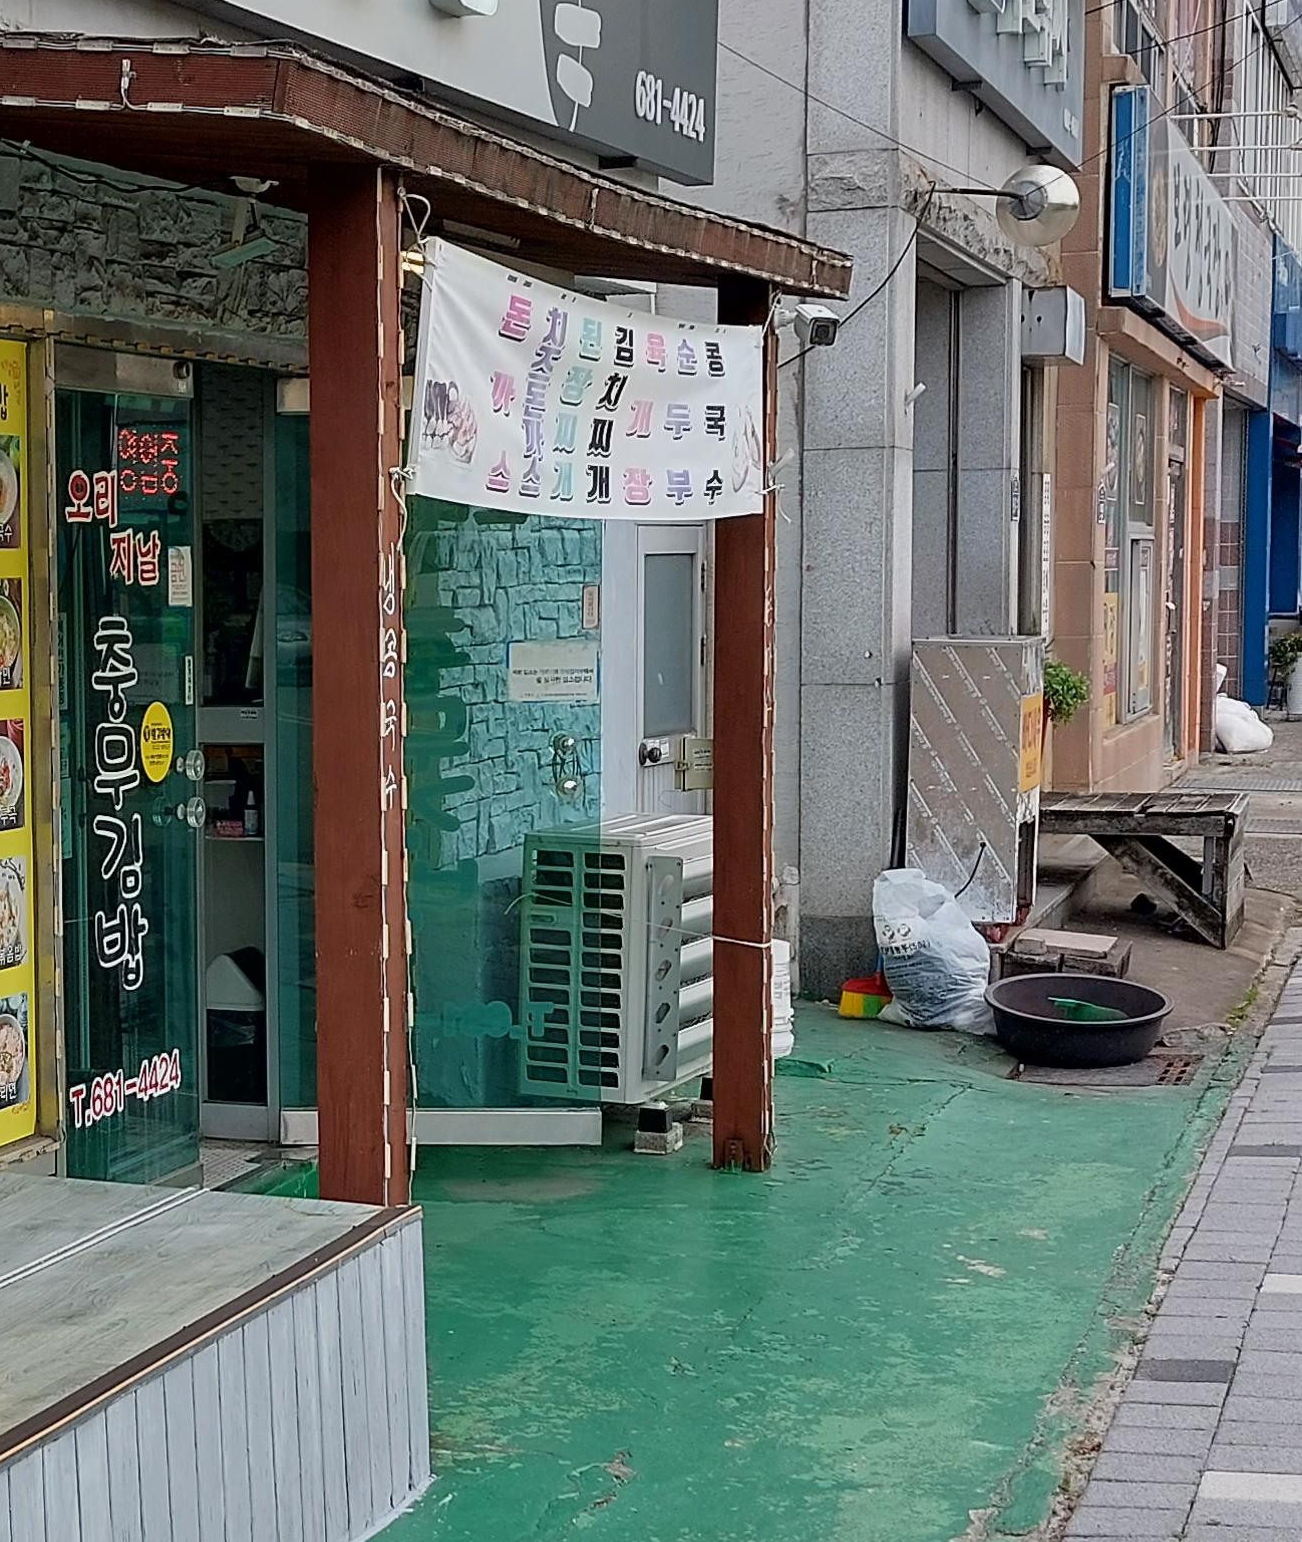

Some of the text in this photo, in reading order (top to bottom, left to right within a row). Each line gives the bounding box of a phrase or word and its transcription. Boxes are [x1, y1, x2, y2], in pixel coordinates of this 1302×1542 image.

[635, 69, 706, 144] 681-4424
[118, 428, 179, 495] 영업중
[486, 295, 532, 492] 돈까스
[519, 306, 569, 498] 치즈돈까스
[550, 316, 603, 501] 된장찌개
[586, 325, 635, 504] 김치찌개
[623, 331, 667, 505] 육개장
[664, 338, 699, 505] 순두부
[704, 339, 727, 505] 콩국수
[65, 470, 118, 528] 오리
[92, 616, 148, 991] 충무김밥
[69, 1048, 181, 1128] T.681-4424
